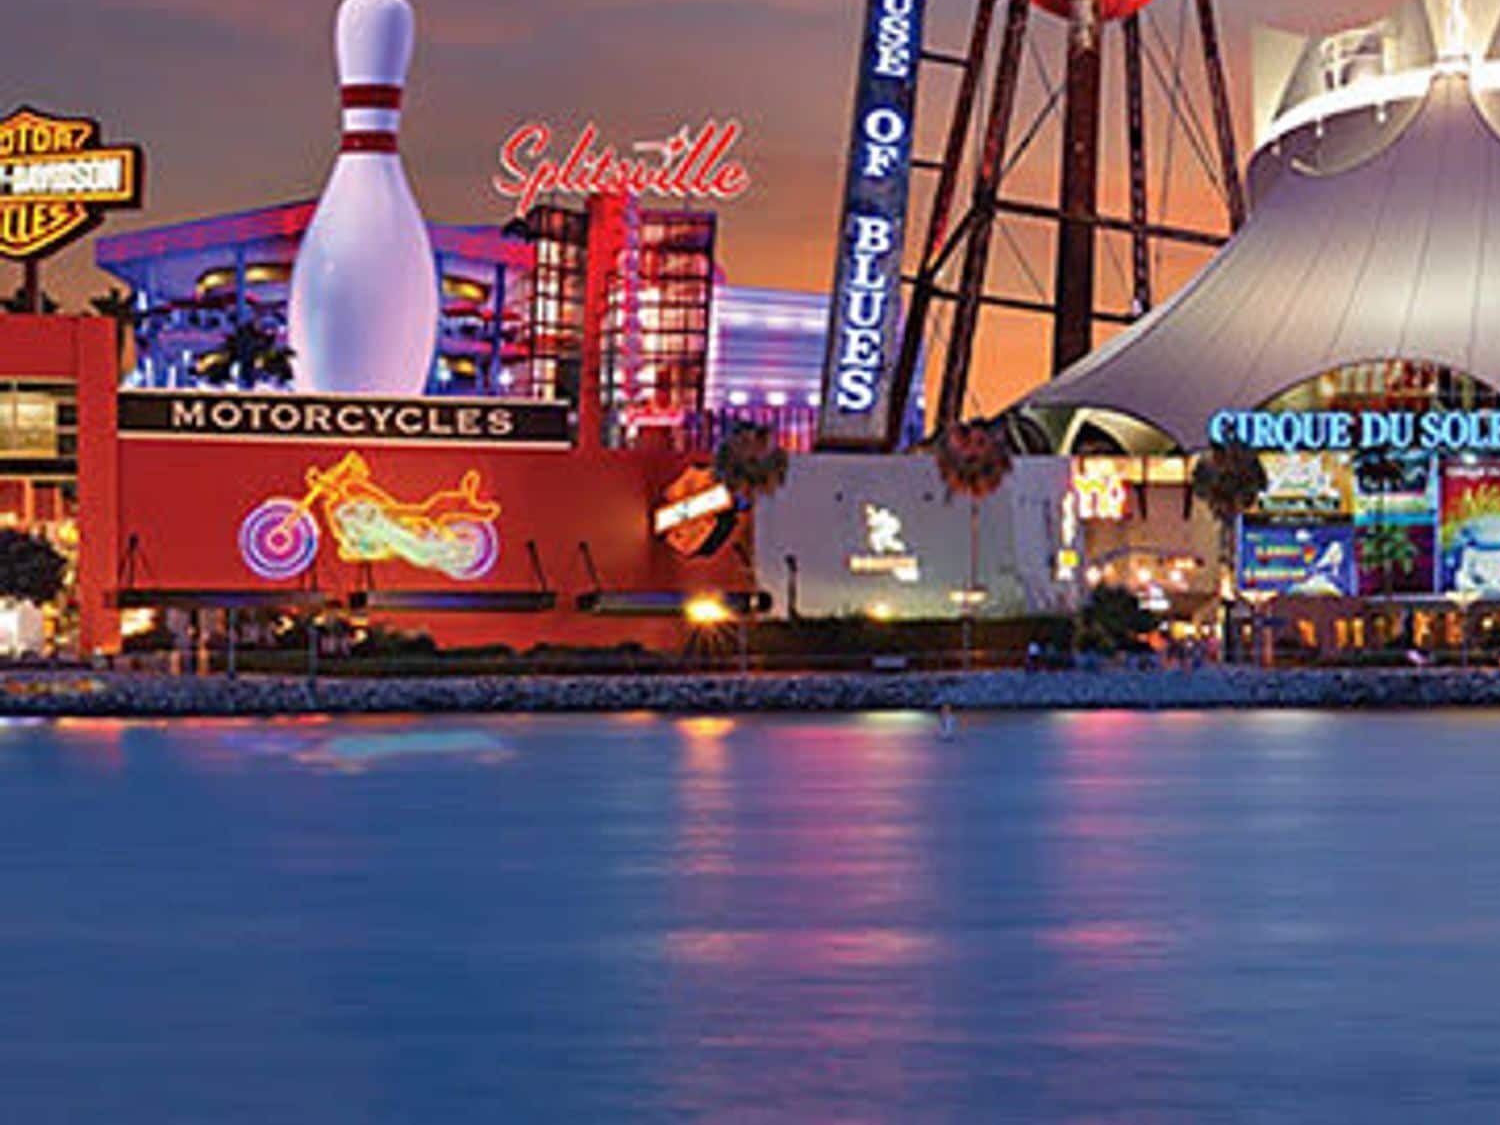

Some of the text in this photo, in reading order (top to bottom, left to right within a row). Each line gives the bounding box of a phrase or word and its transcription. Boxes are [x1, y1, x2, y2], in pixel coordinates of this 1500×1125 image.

[492, 120, 751, 218] Splitsville
[862, 108, 905, 177] OF
[837, 215, 891, 411] BLUES
[170, 400, 514, 435] MOTORCYCLES
[1209, 410, 1353, 450] CIRQUE
[1361, 411, 1415, 447] DU
